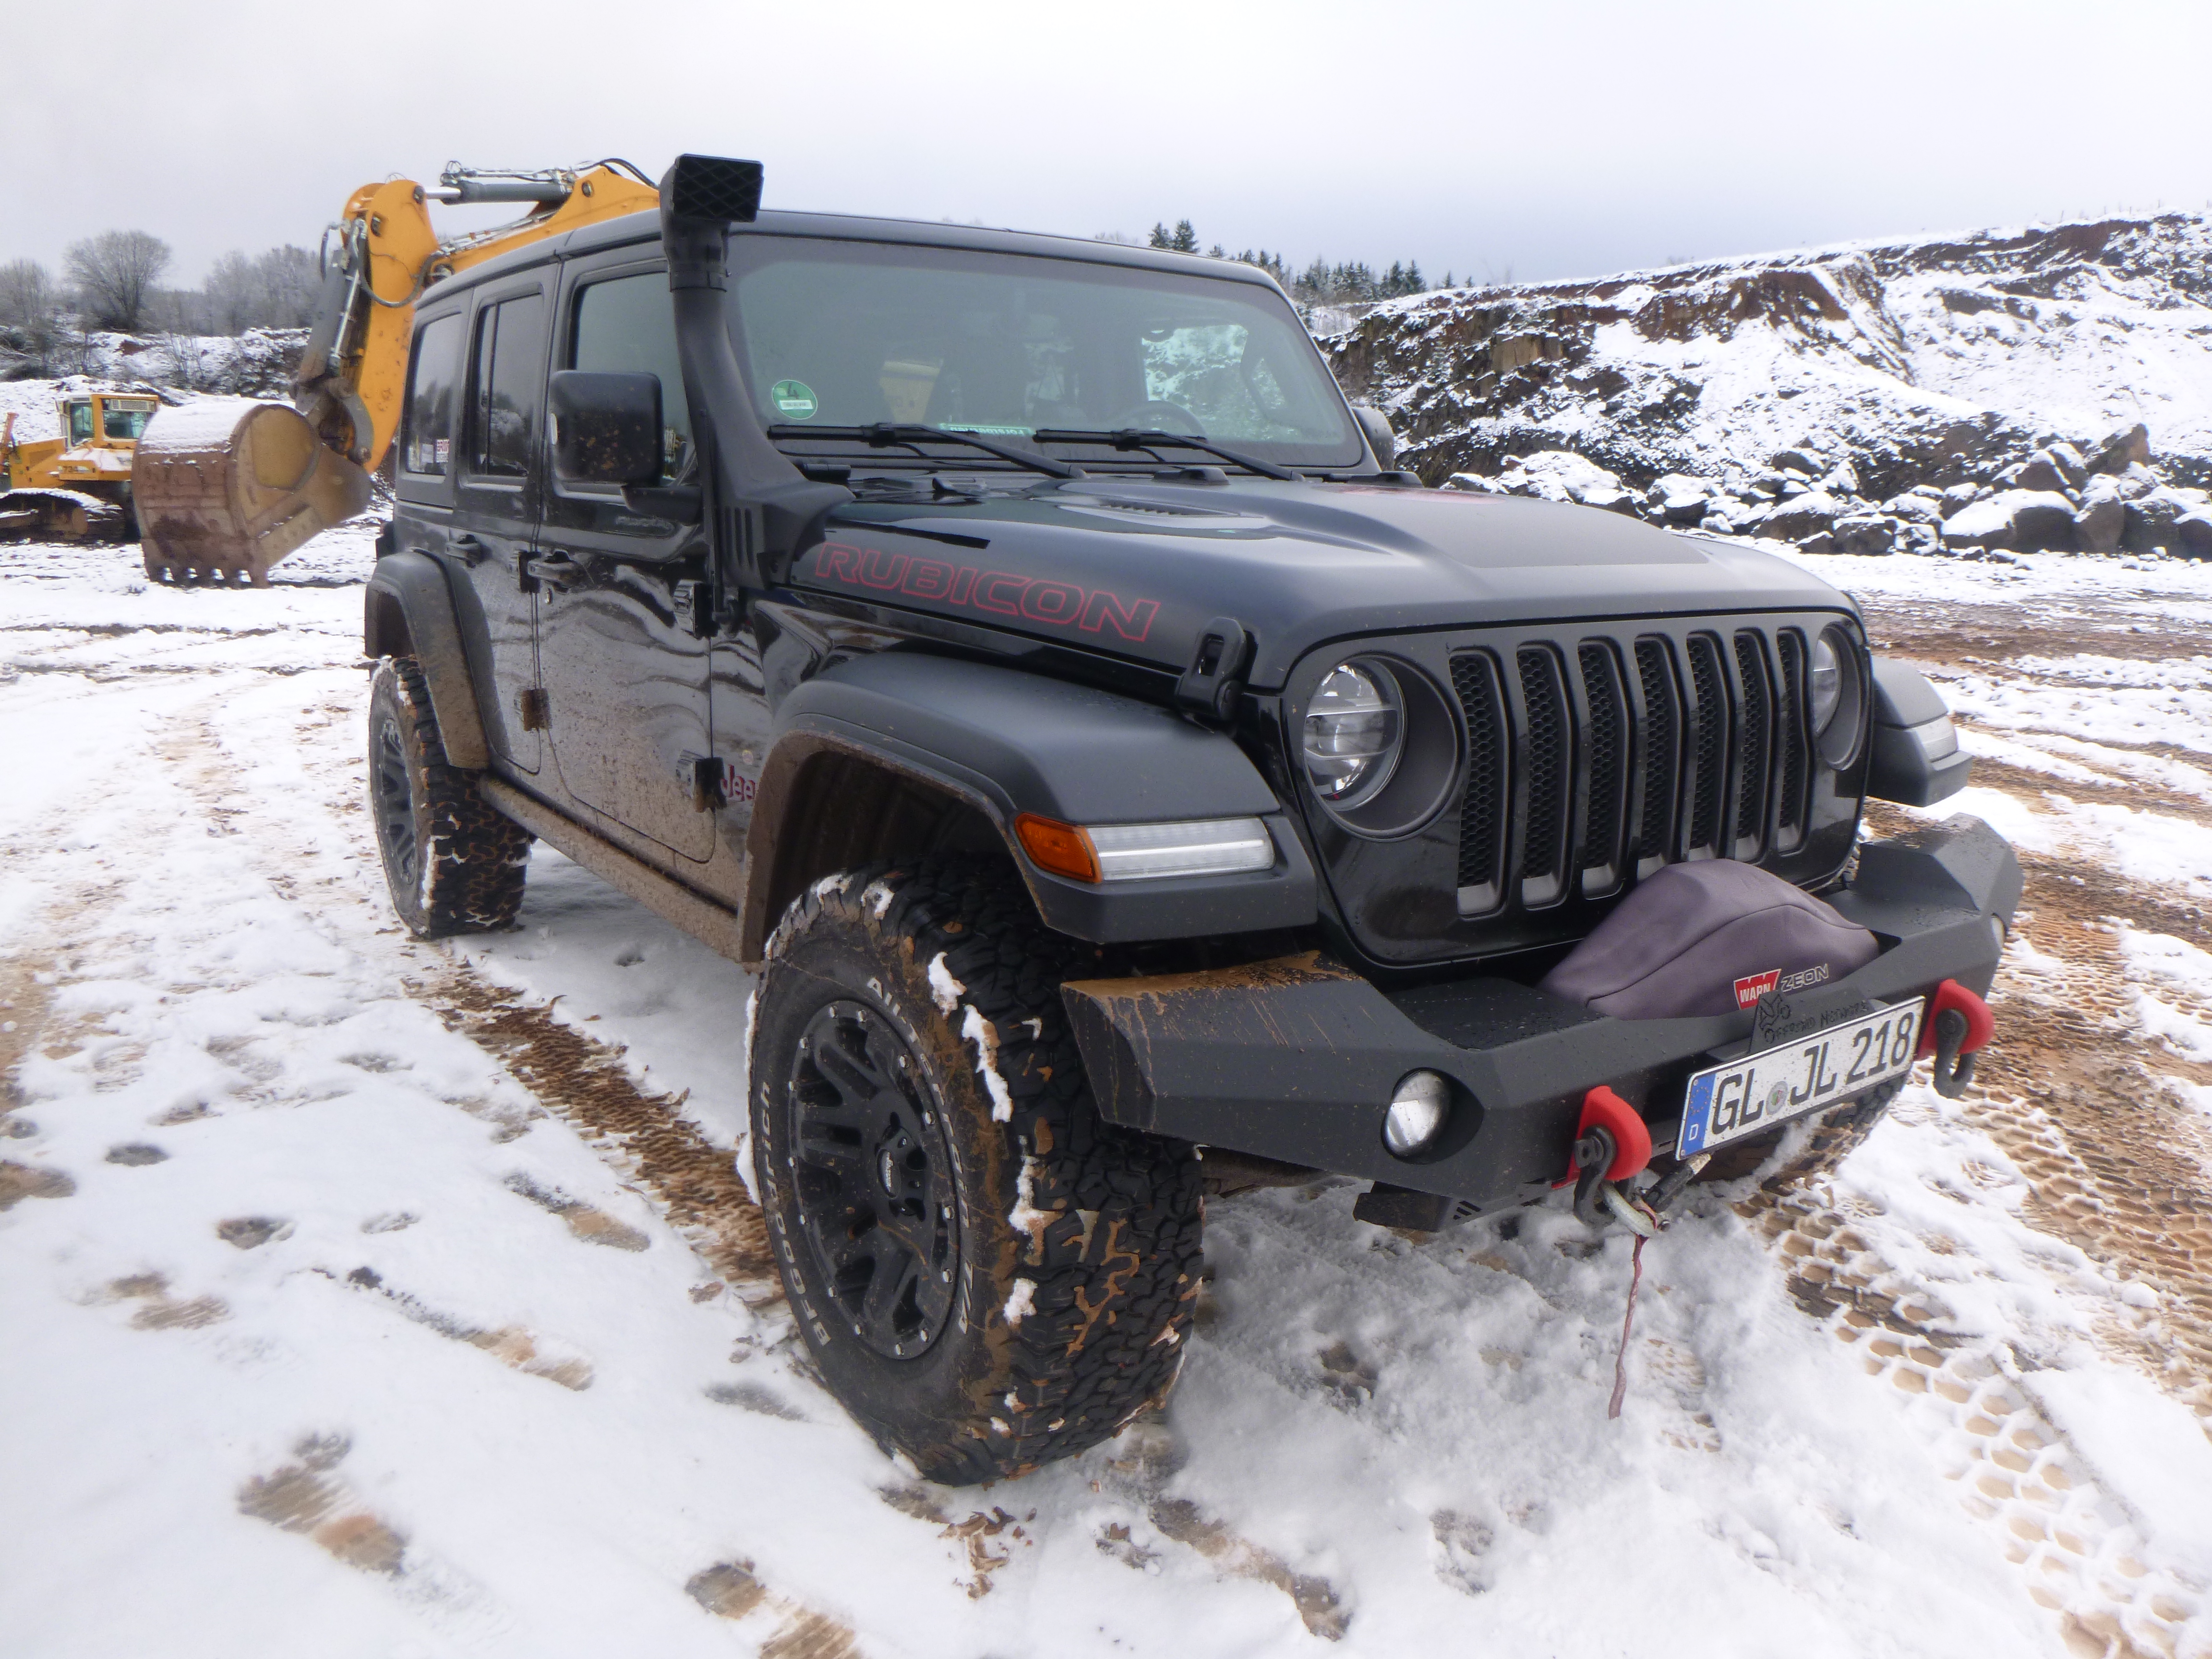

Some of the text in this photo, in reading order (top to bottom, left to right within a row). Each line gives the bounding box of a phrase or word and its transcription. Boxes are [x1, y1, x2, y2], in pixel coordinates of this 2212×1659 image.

[787, 382, 799, 399] 4
[815, 541, 1161, 642] RUBICON
[720, 764, 757, 801] Jee
[1740, 963, 1829, 1003] WARN ZEON
[1688, 1011, 1914, 1141] D GL JL 218
[760, 1082, 831, 1346] BFGoodrich
